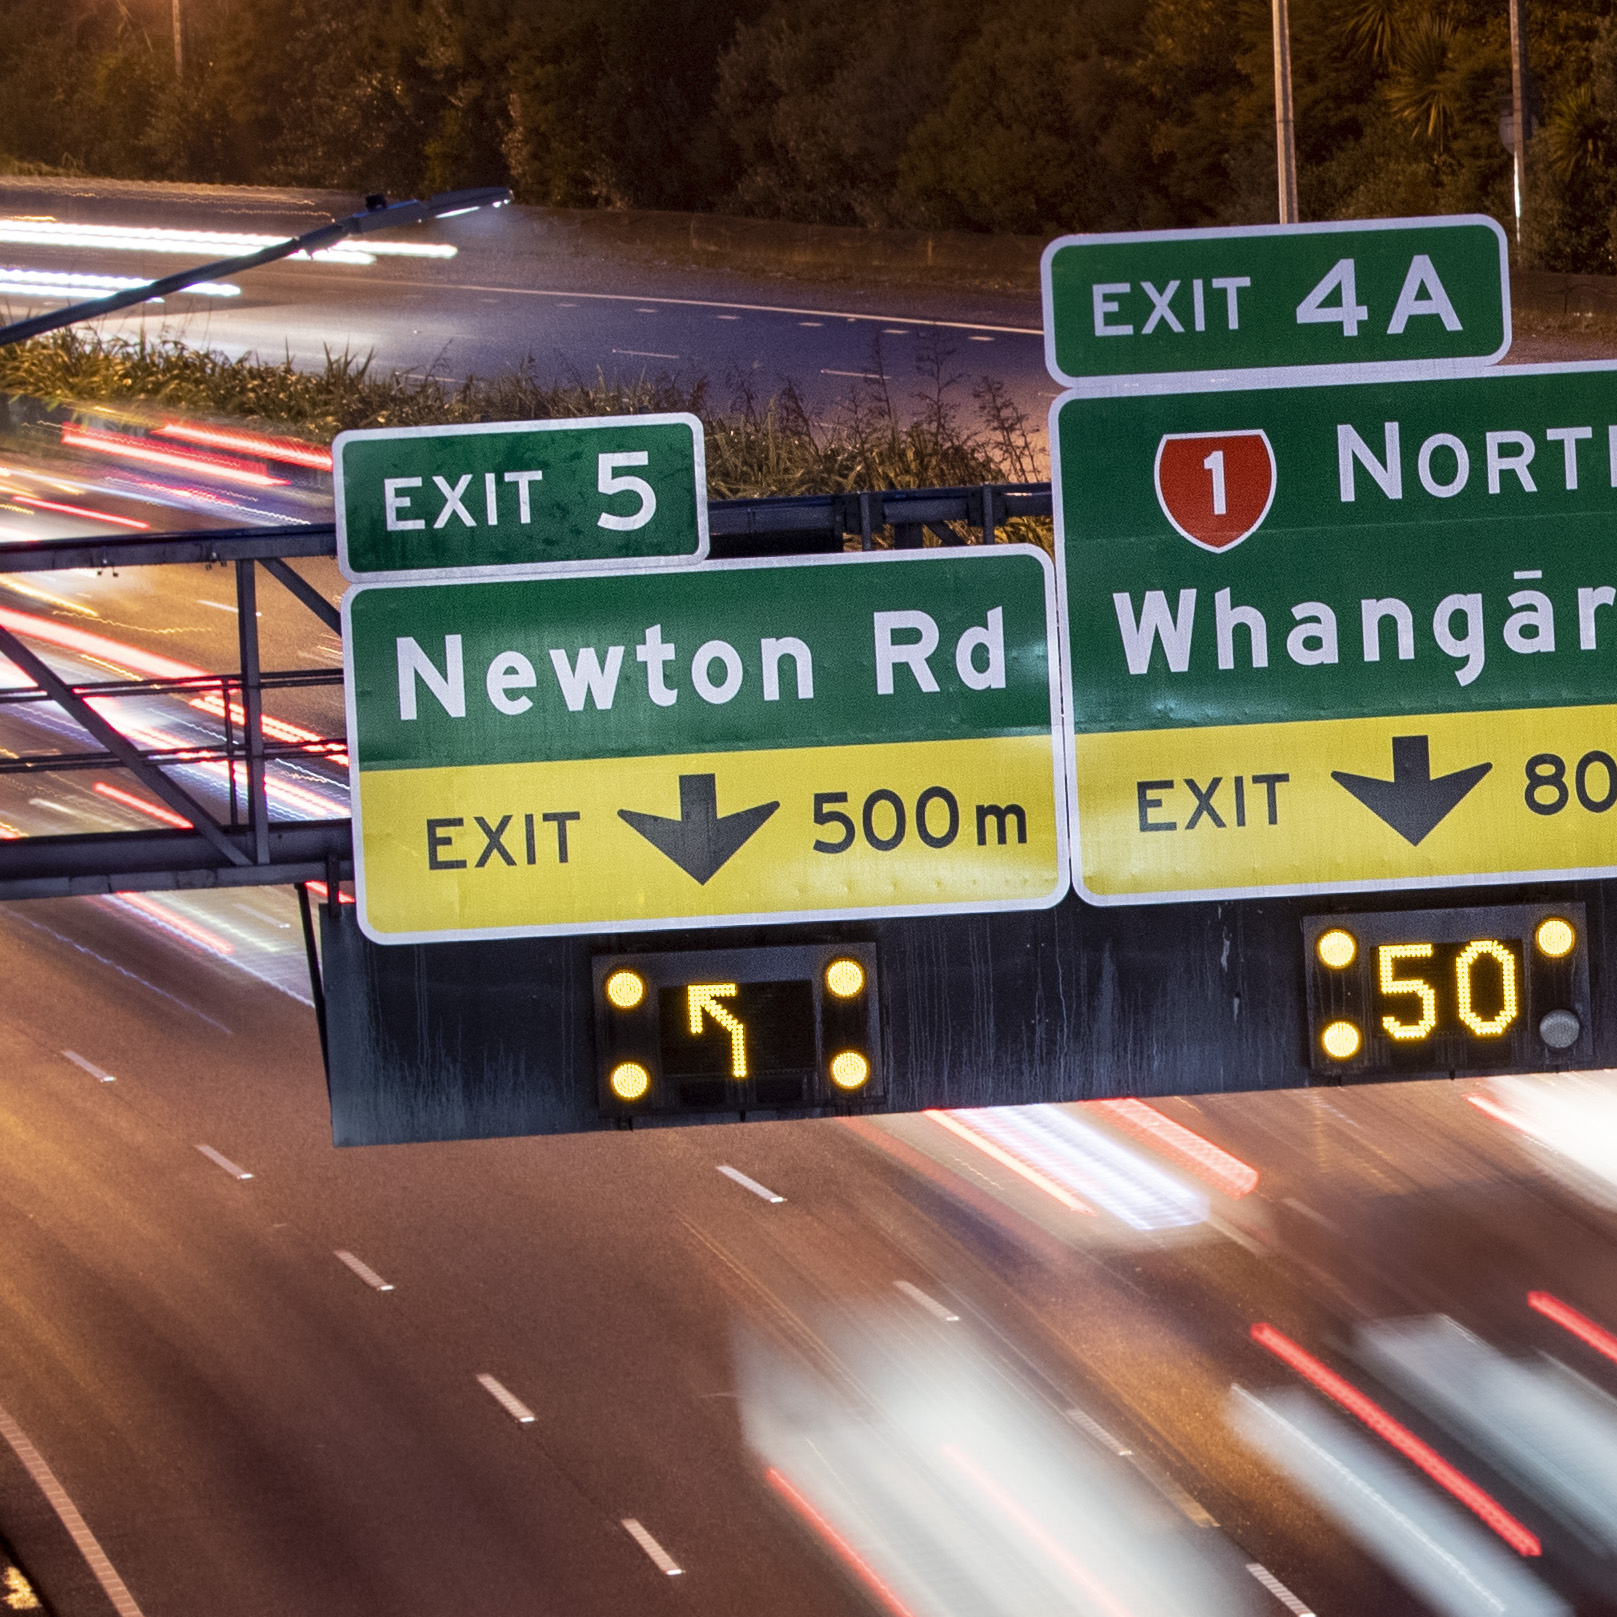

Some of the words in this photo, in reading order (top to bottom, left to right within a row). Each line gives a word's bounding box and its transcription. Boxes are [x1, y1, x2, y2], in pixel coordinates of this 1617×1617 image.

[1092, 276, 1252, 337] EXIT
[1295, 254, 1463, 337] 4A
[383, 469, 543, 531] EXIT
[597, 450, 657, 531] 5
[1203, 450, 1227, 516] 1
[396, 624, 814, 721] Newton
[873, 606, 1006, 695] Rd
[425, 810, 581, 871] EXIT
[1136, 772, 1290, 833] EXIT
[1378, 939, 1518, 1041] 50
